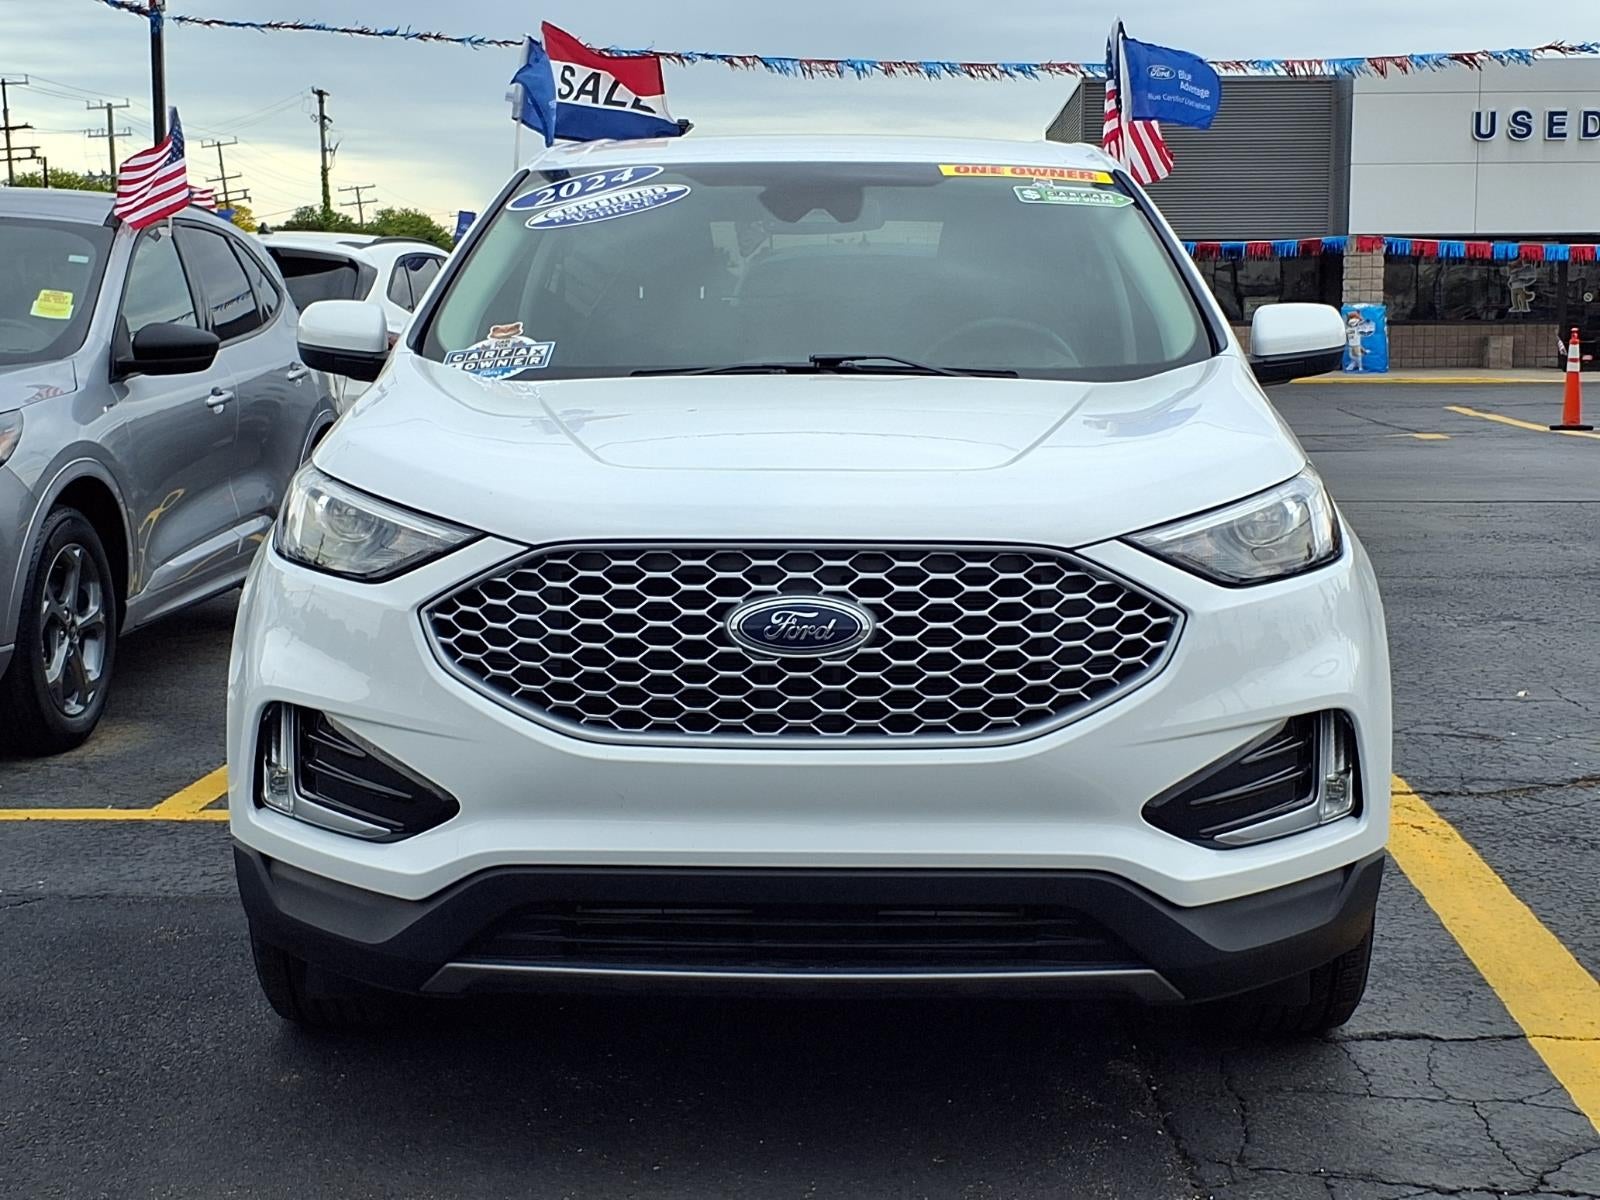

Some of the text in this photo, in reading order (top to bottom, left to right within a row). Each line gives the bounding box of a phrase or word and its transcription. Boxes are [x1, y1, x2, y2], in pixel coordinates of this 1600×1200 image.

[1150, 66, 1170, 77] Ford
[1473, 109, 1600, 140] USED
[954, 165, 1093, 180] ONE OWNER
[534, 168, 634, 206] 2024
[545, 186, 668, 219] CERTIFIED
[452, 347, 545, 362] CARFAX
[463, 356, 542, 370] OWNER
[763, 610, 837, 640] Ford
